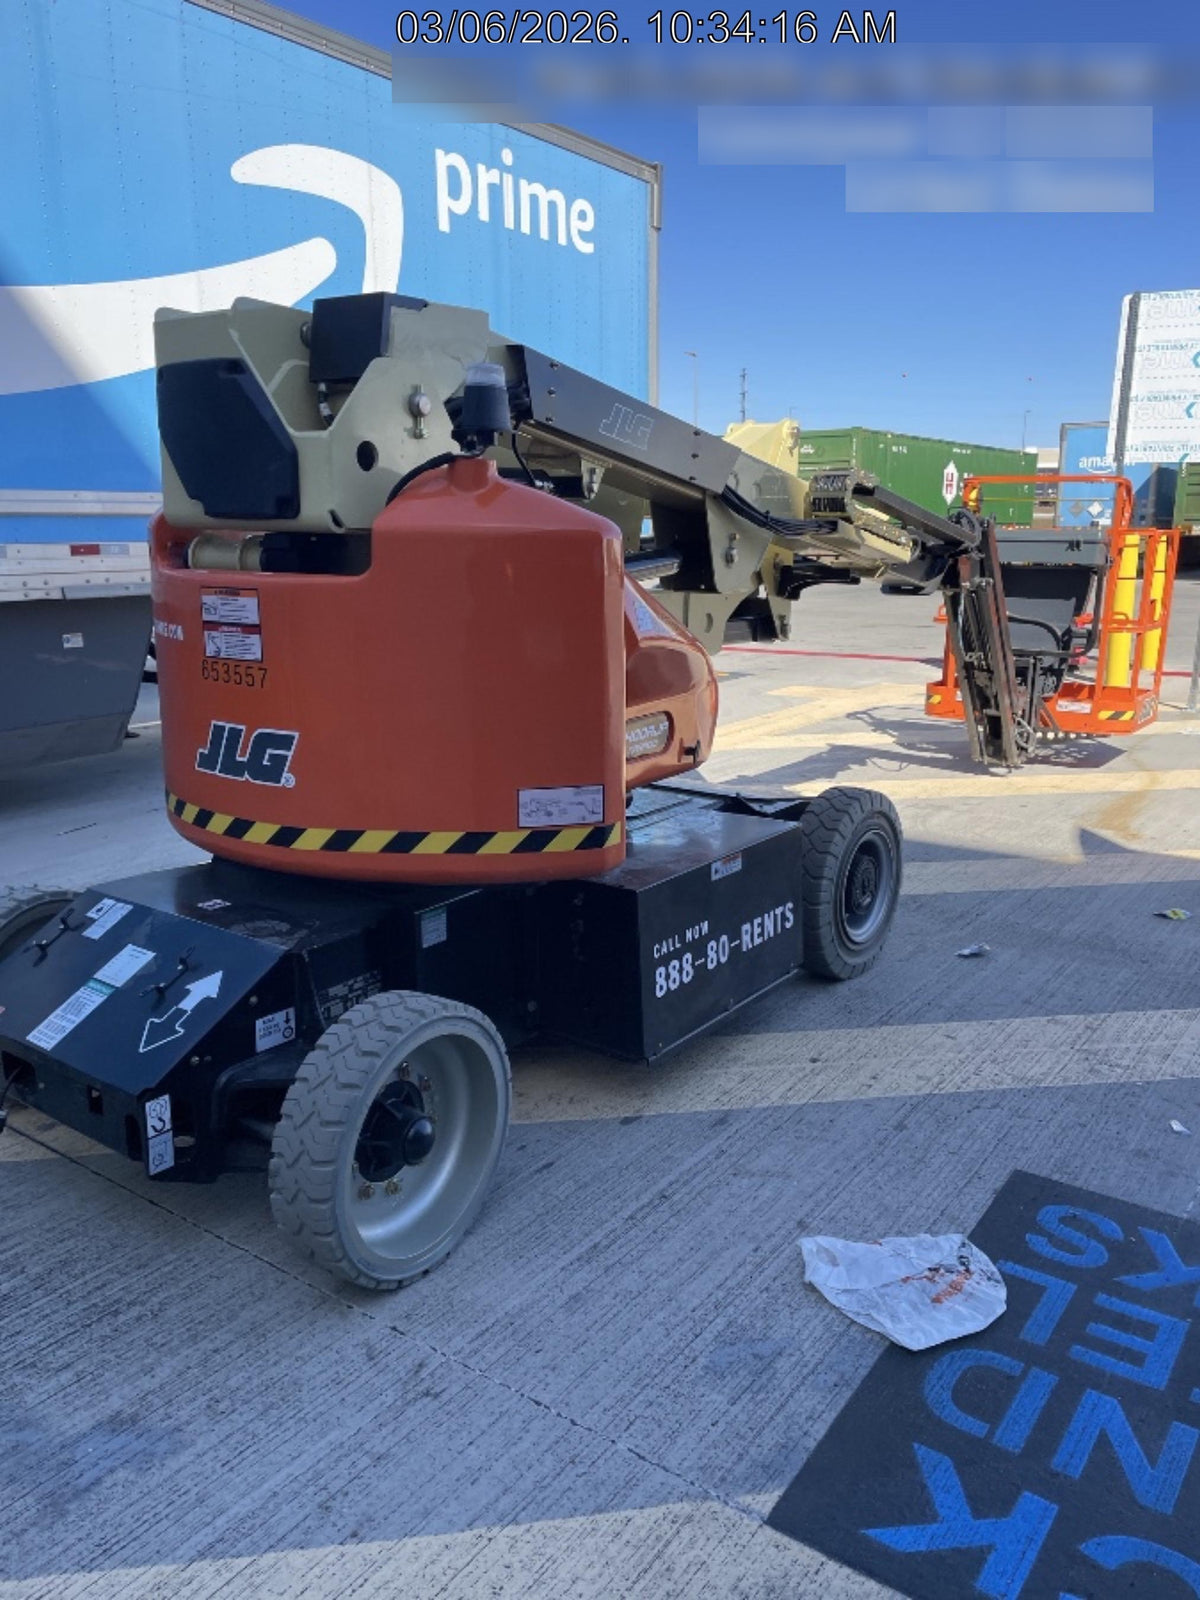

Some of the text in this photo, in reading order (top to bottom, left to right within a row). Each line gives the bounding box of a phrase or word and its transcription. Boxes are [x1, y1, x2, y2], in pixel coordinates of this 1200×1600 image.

[434, 146, 596, 255] prime
[598, 402, 655, 450] JLG
[202, 659, 268, 688] 653557
[195, 721, 300, 788] JLG
[653, 920, 709, 959] CALL NOW
[655, 902, 795, 999] 888-80-RENTS
